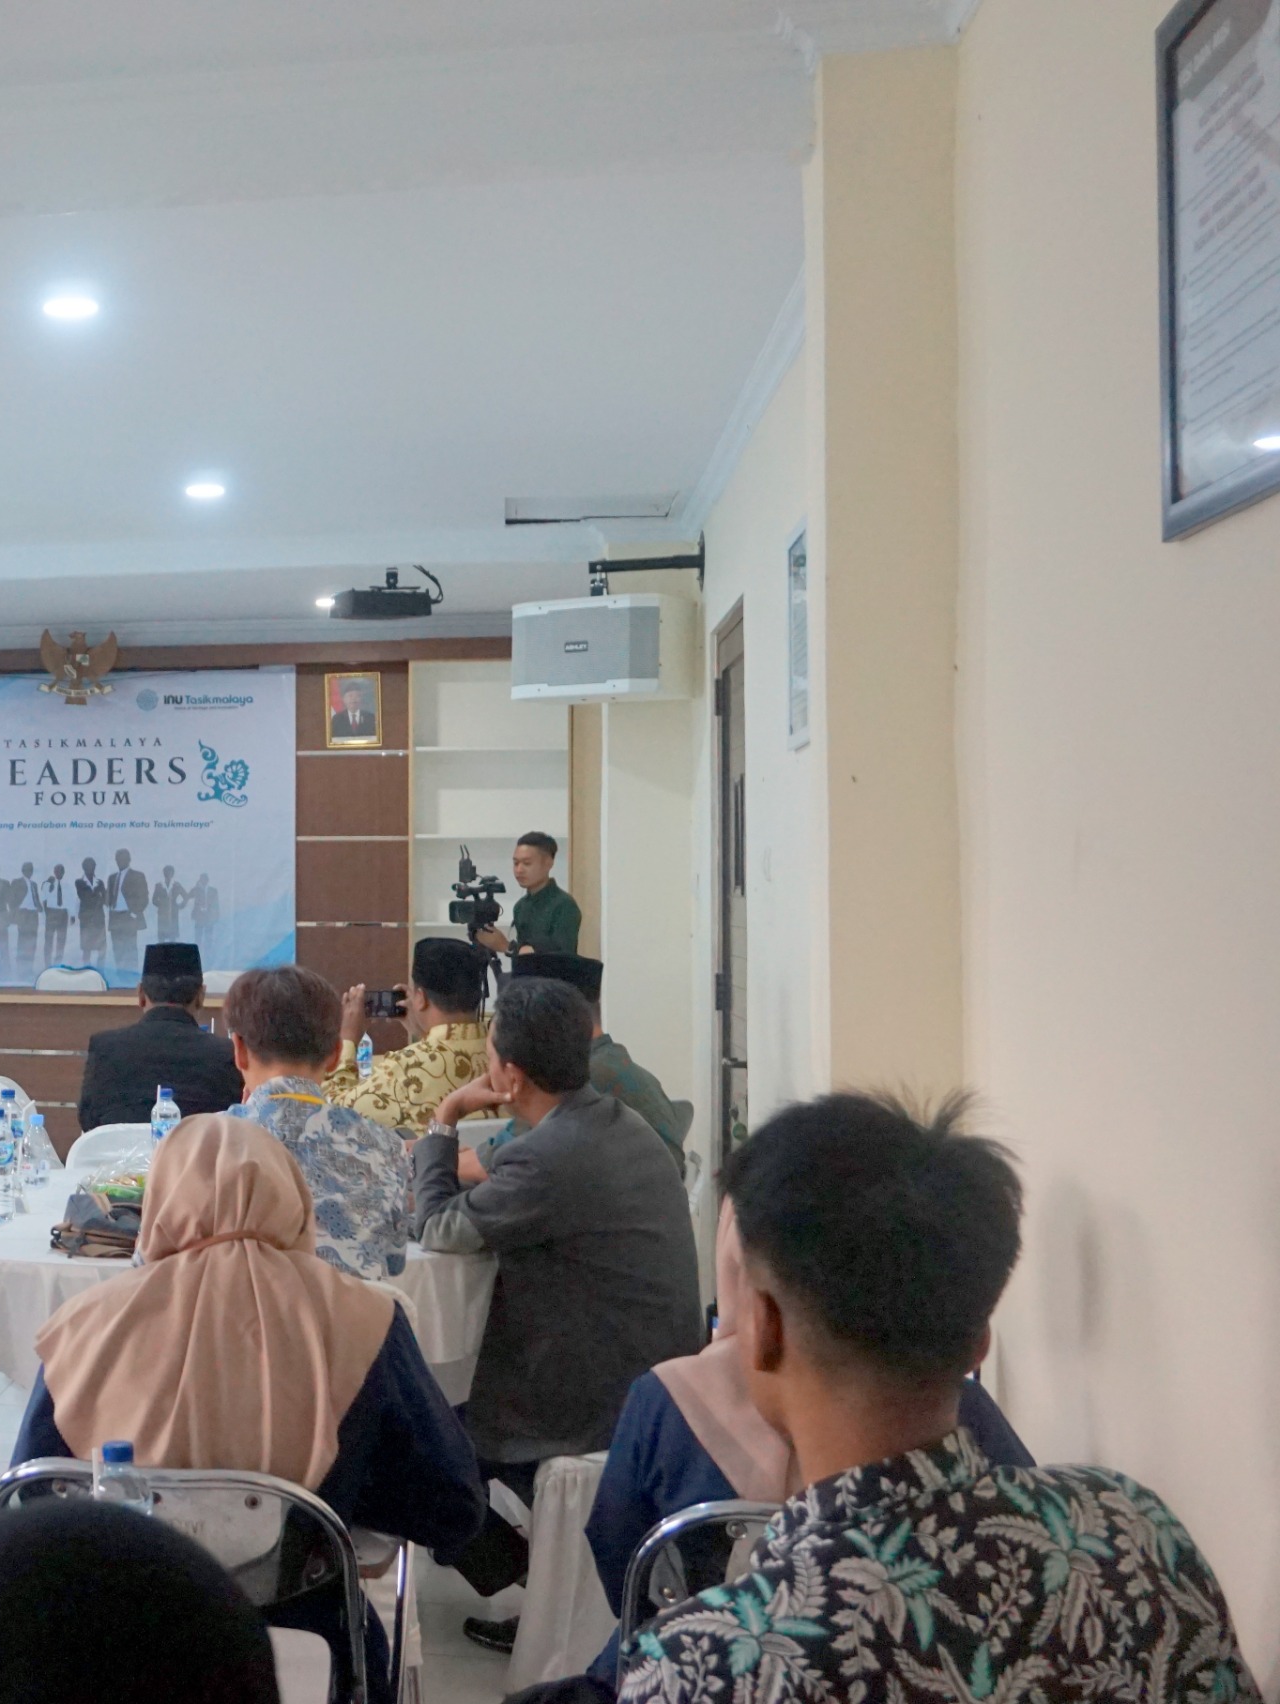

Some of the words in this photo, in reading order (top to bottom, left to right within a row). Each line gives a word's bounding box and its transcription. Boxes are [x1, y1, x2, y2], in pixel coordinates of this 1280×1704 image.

[185, 694, 254, 707] Tasikmalaya
[3, 737, 163, 749] TASIKMALAYA
[33, 790, 132, 806] FORUM
[17, 820, 67, 829] Peradaban
[69, 820, 94, 829] Masa
[96, 820, 126, 830] Depan
